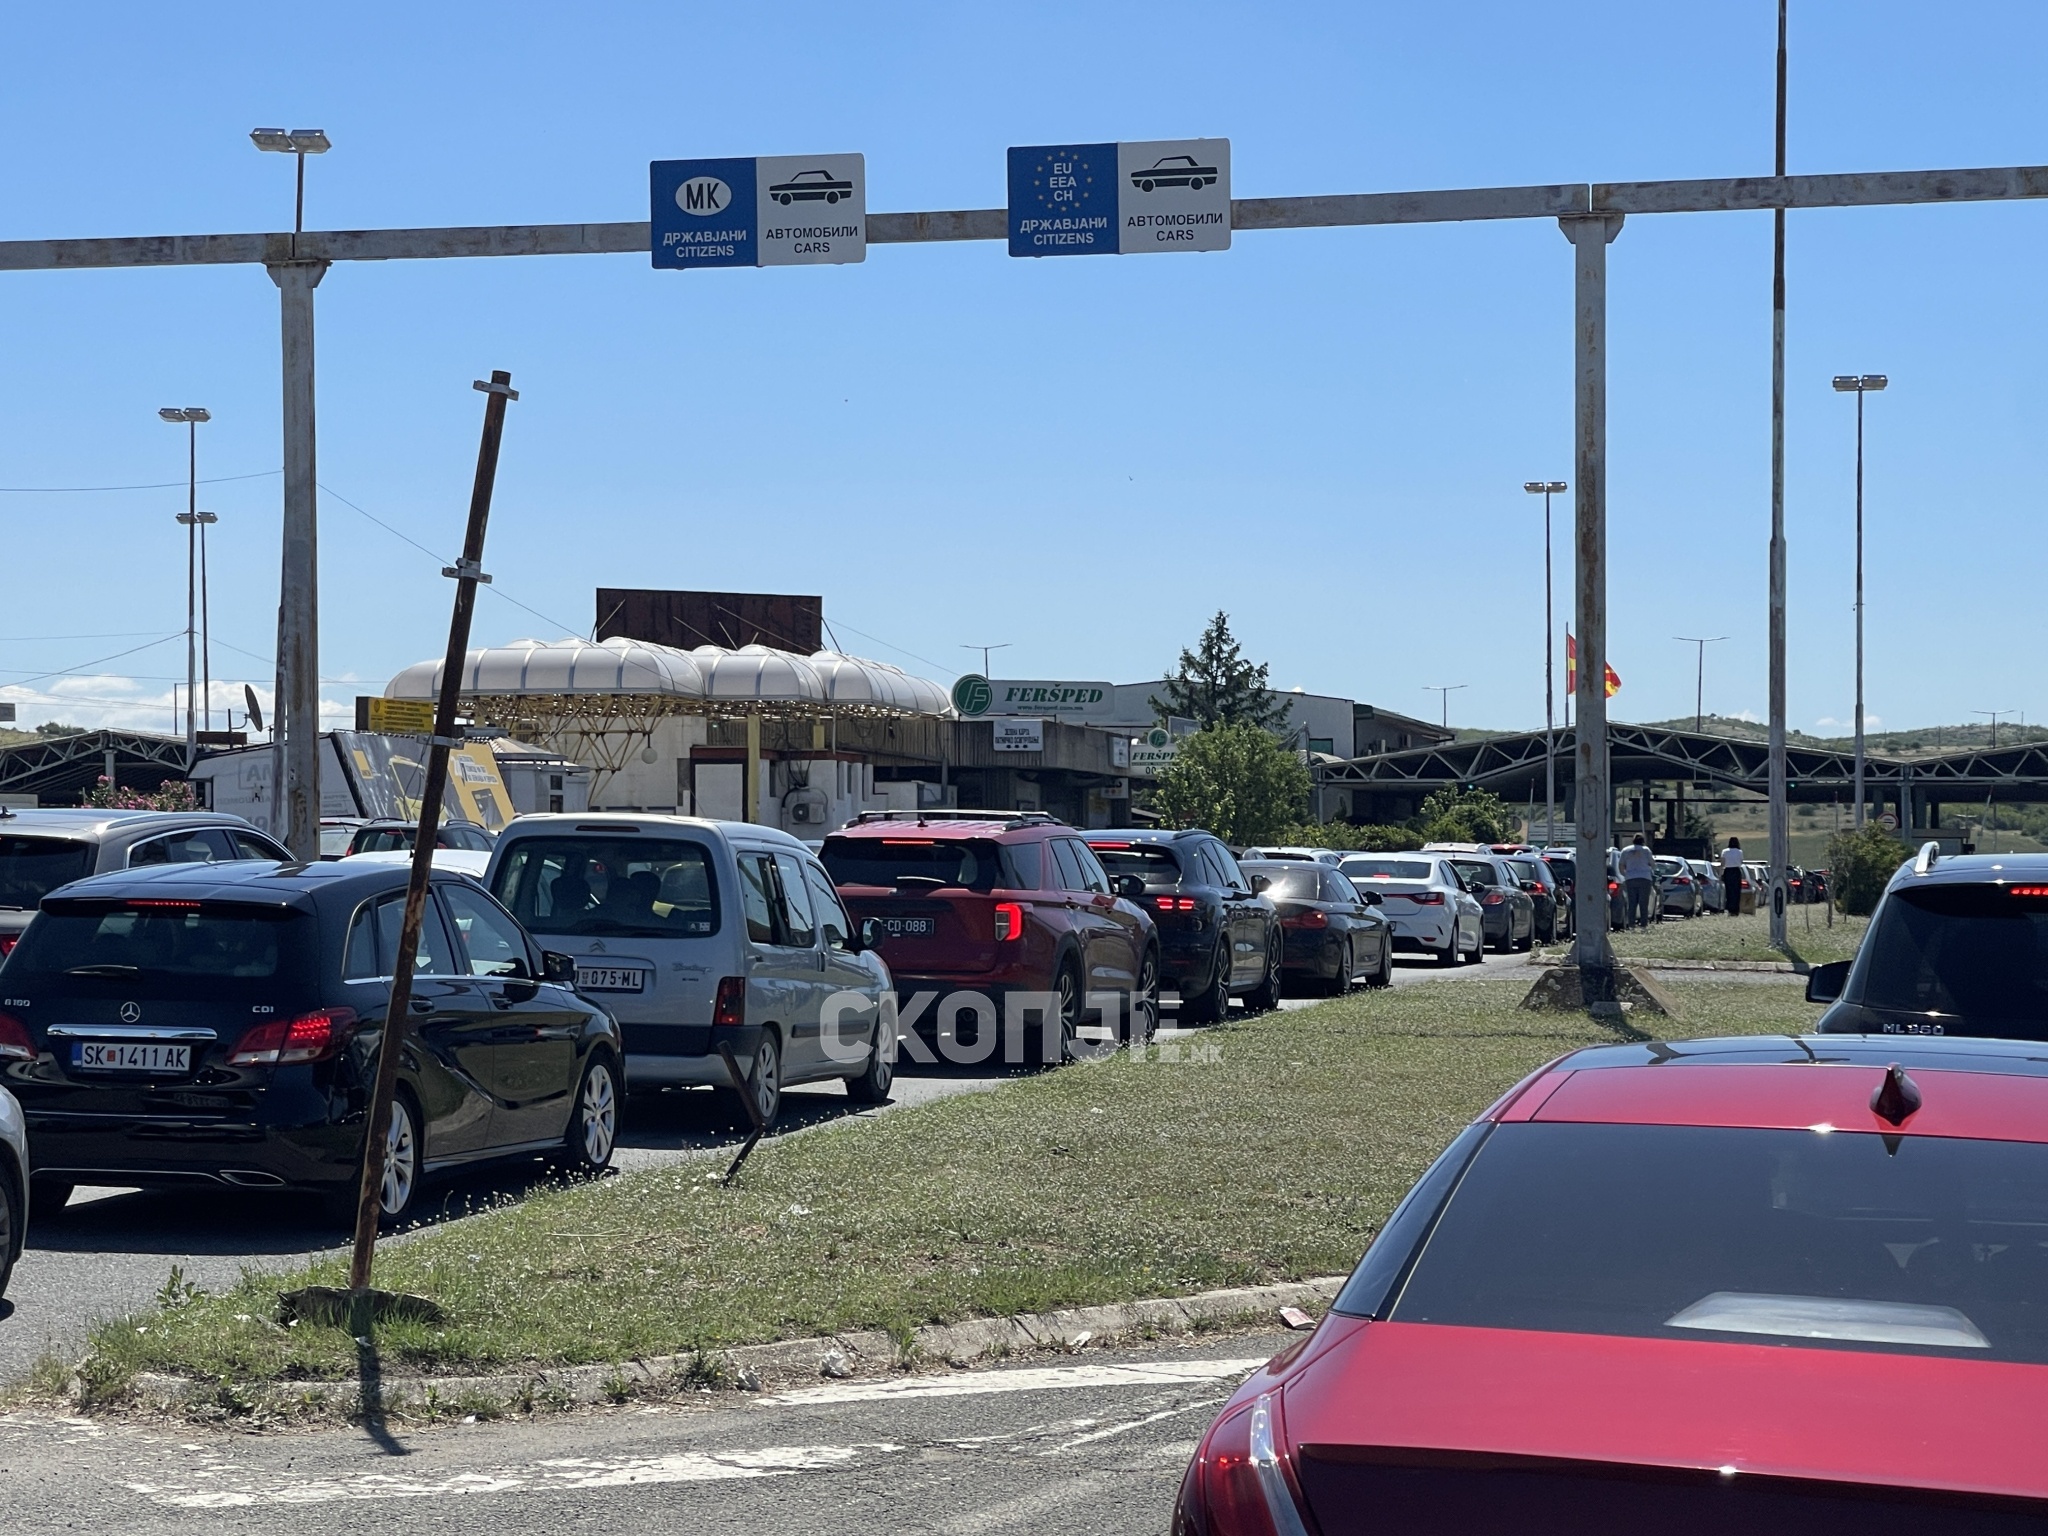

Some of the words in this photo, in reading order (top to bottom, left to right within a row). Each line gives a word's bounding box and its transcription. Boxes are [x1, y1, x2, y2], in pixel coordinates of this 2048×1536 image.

[1053, 162, 1073, 174] EU
[1050, 176, 1077, 188] EEA
[686, 182, 720, 209] MK
[1053, 190, 1073, 202] CH
[1020, 217, 1107, 234] ДРЖАВЈАНИ
[1127, 213, 1223, 227] АВТОМОБИЛИ
[663, 230, 747, 246] ДРЖАВЈАНИ
[766, 226, 858, 239] АВТОМОБИЛИ
[1156, 229, 1194, 242] CARS
[1033, 233, 1094, 246] CITIZENS
[676, 245, 735, 258] CITIZENS
[794, 242, 831, 254] CARS
[1005, 683, 1103, 703] FERŠPED
[252, 1005, 274, 1013] CDI
[1883, 1023, 1905, 1034] ML
[1907, 1024, 1945, 1036] 350
[84, 1045, 106, 1065] SK
[118, 1046, 158, 1067] 1411
[164, 1048, 187, 1068] AK
